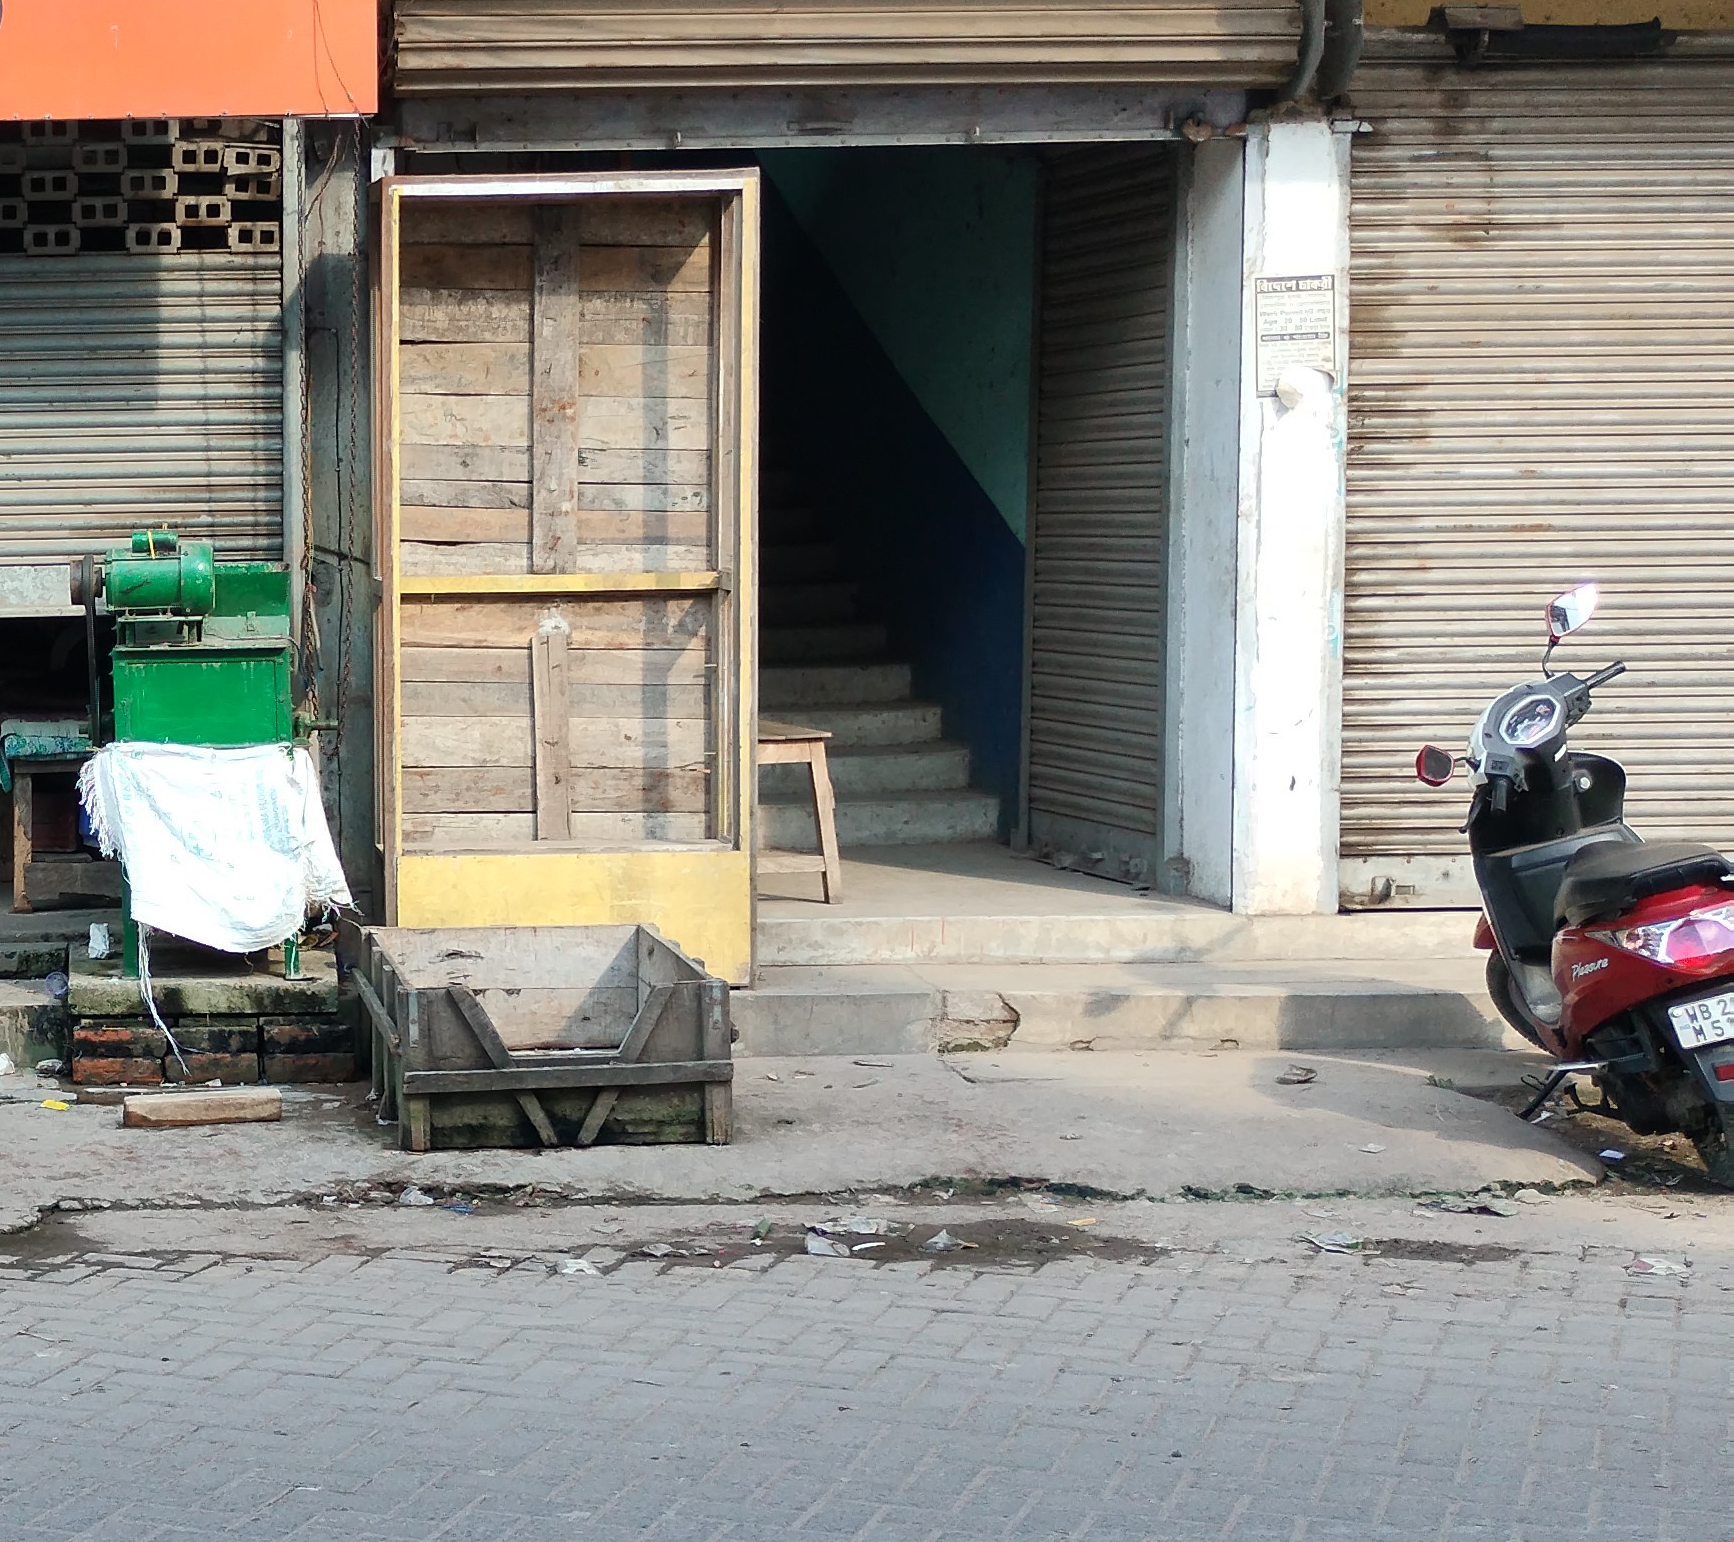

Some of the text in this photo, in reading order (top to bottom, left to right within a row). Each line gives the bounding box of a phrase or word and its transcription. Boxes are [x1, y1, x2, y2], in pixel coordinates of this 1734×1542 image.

[1571, 958, 1609, 982] Pleasure
[1685, 1003, 1712, 1024] WB
[1692, 1025, 1707, 1043] M
